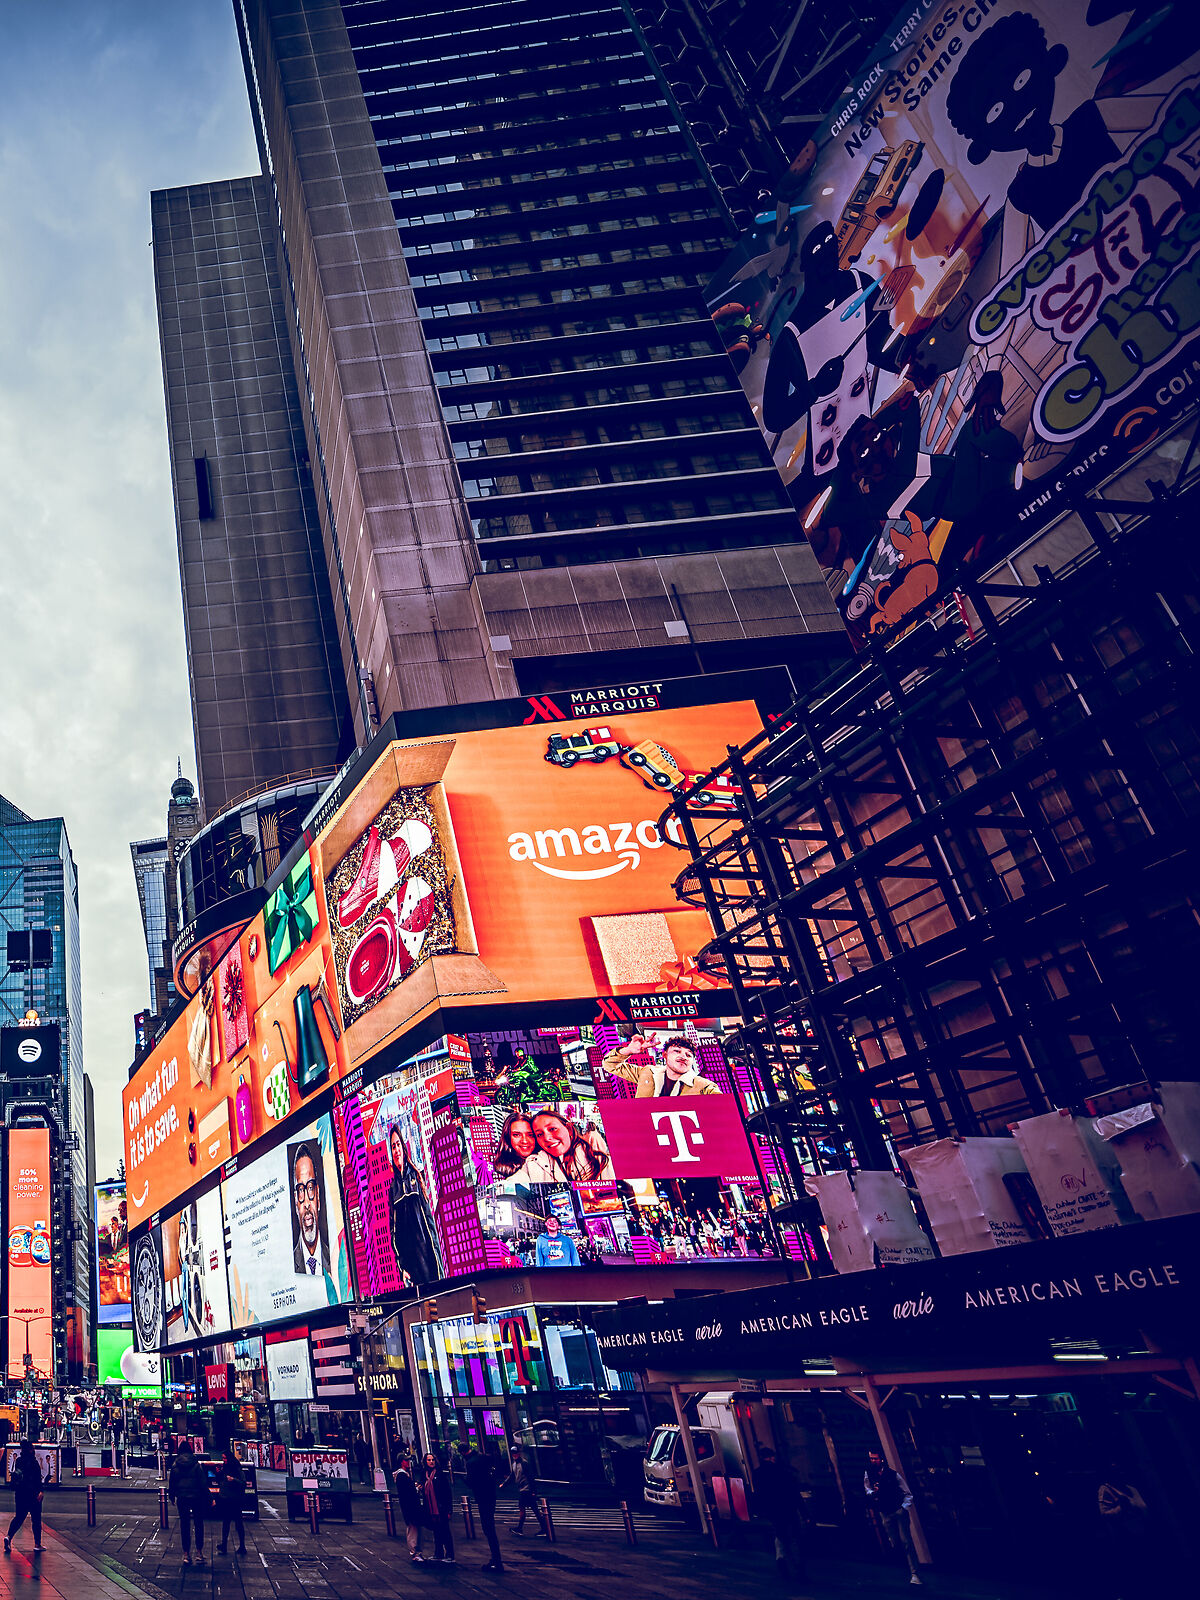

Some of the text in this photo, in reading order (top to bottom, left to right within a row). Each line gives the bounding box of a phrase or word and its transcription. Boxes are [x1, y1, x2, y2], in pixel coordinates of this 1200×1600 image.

[890, 8, 922, 53] TERRY
[903, 37, 963, 111] Same
[831, 61, 884, 137] CHRIS ROCK
[844, 104, 885, 158] New
[570, 683, 663, 704] MARRIOTT
[574, 697, 657, 716] MARQUIS
[629, 994, 700, 1007] MARRIOTT
[633, 1006, 696, 1018] MARQUIS
[18, 1018, 41, 1027] 2024
[701, 1038, 718, 1046] NYC
[341, 1068, 364, 1088] MARRIOTT
[343, 1078, 363, 1098] MARQUIS
[129, 1056, 179, 1132] Oh what fun
[434, 1111, 451, 1131] NYC
[130, 1104, 180, 1171] it is to save.
[13, 1184, 44, 1192] cleaning
[16, 1191, 41, 1199] power.
[965, 1265, 1180, 1310] AMERICAN EAGLE
[273, 1294, 297, 1309] SEPHORA
[893, 1292, 934, 1319] aerie
[695, 1319, 723, 1341] aerie
[740, 1305, 870, 1335] AMERICAN EAGLE
[597, 1329, 684, 1349] AMERICAN EAGLE
[277, 1364, 300, 1376] VORNADO
[139, 1388, 158, 1396] YORK
[292, 1453, 348, 1464] CHICAGO
